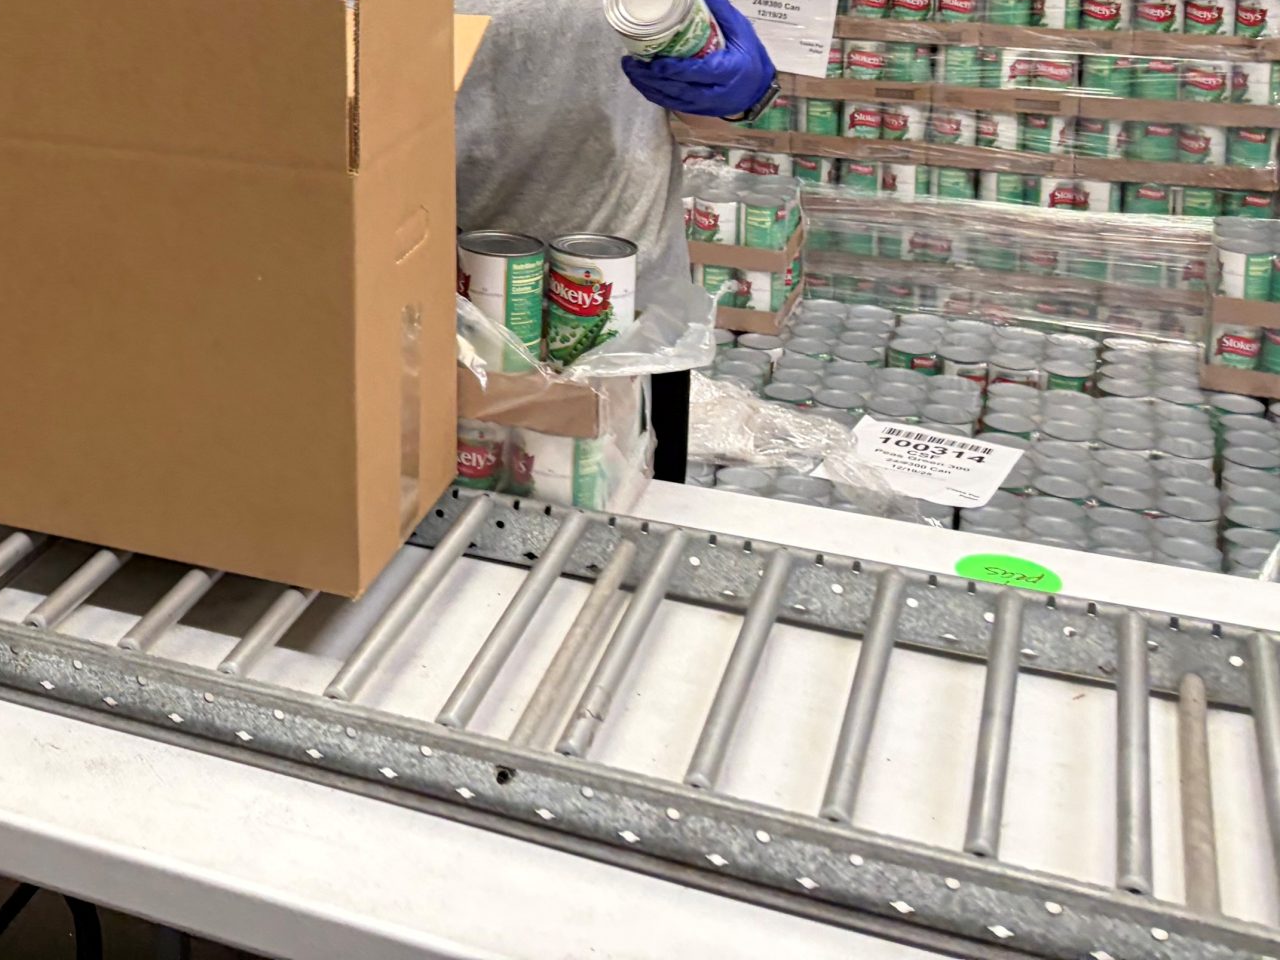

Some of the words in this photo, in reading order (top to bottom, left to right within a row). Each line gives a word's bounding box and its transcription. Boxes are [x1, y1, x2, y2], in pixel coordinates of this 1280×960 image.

[784, 3, 801, 11] Can
[880, 436, 986, 463] 100314
[907, 450, 940, 459] CSF
[874, 448, 904, 458] Peas
[908, 455, 944, 467] Green
[948, 464, 970, 472] 300
